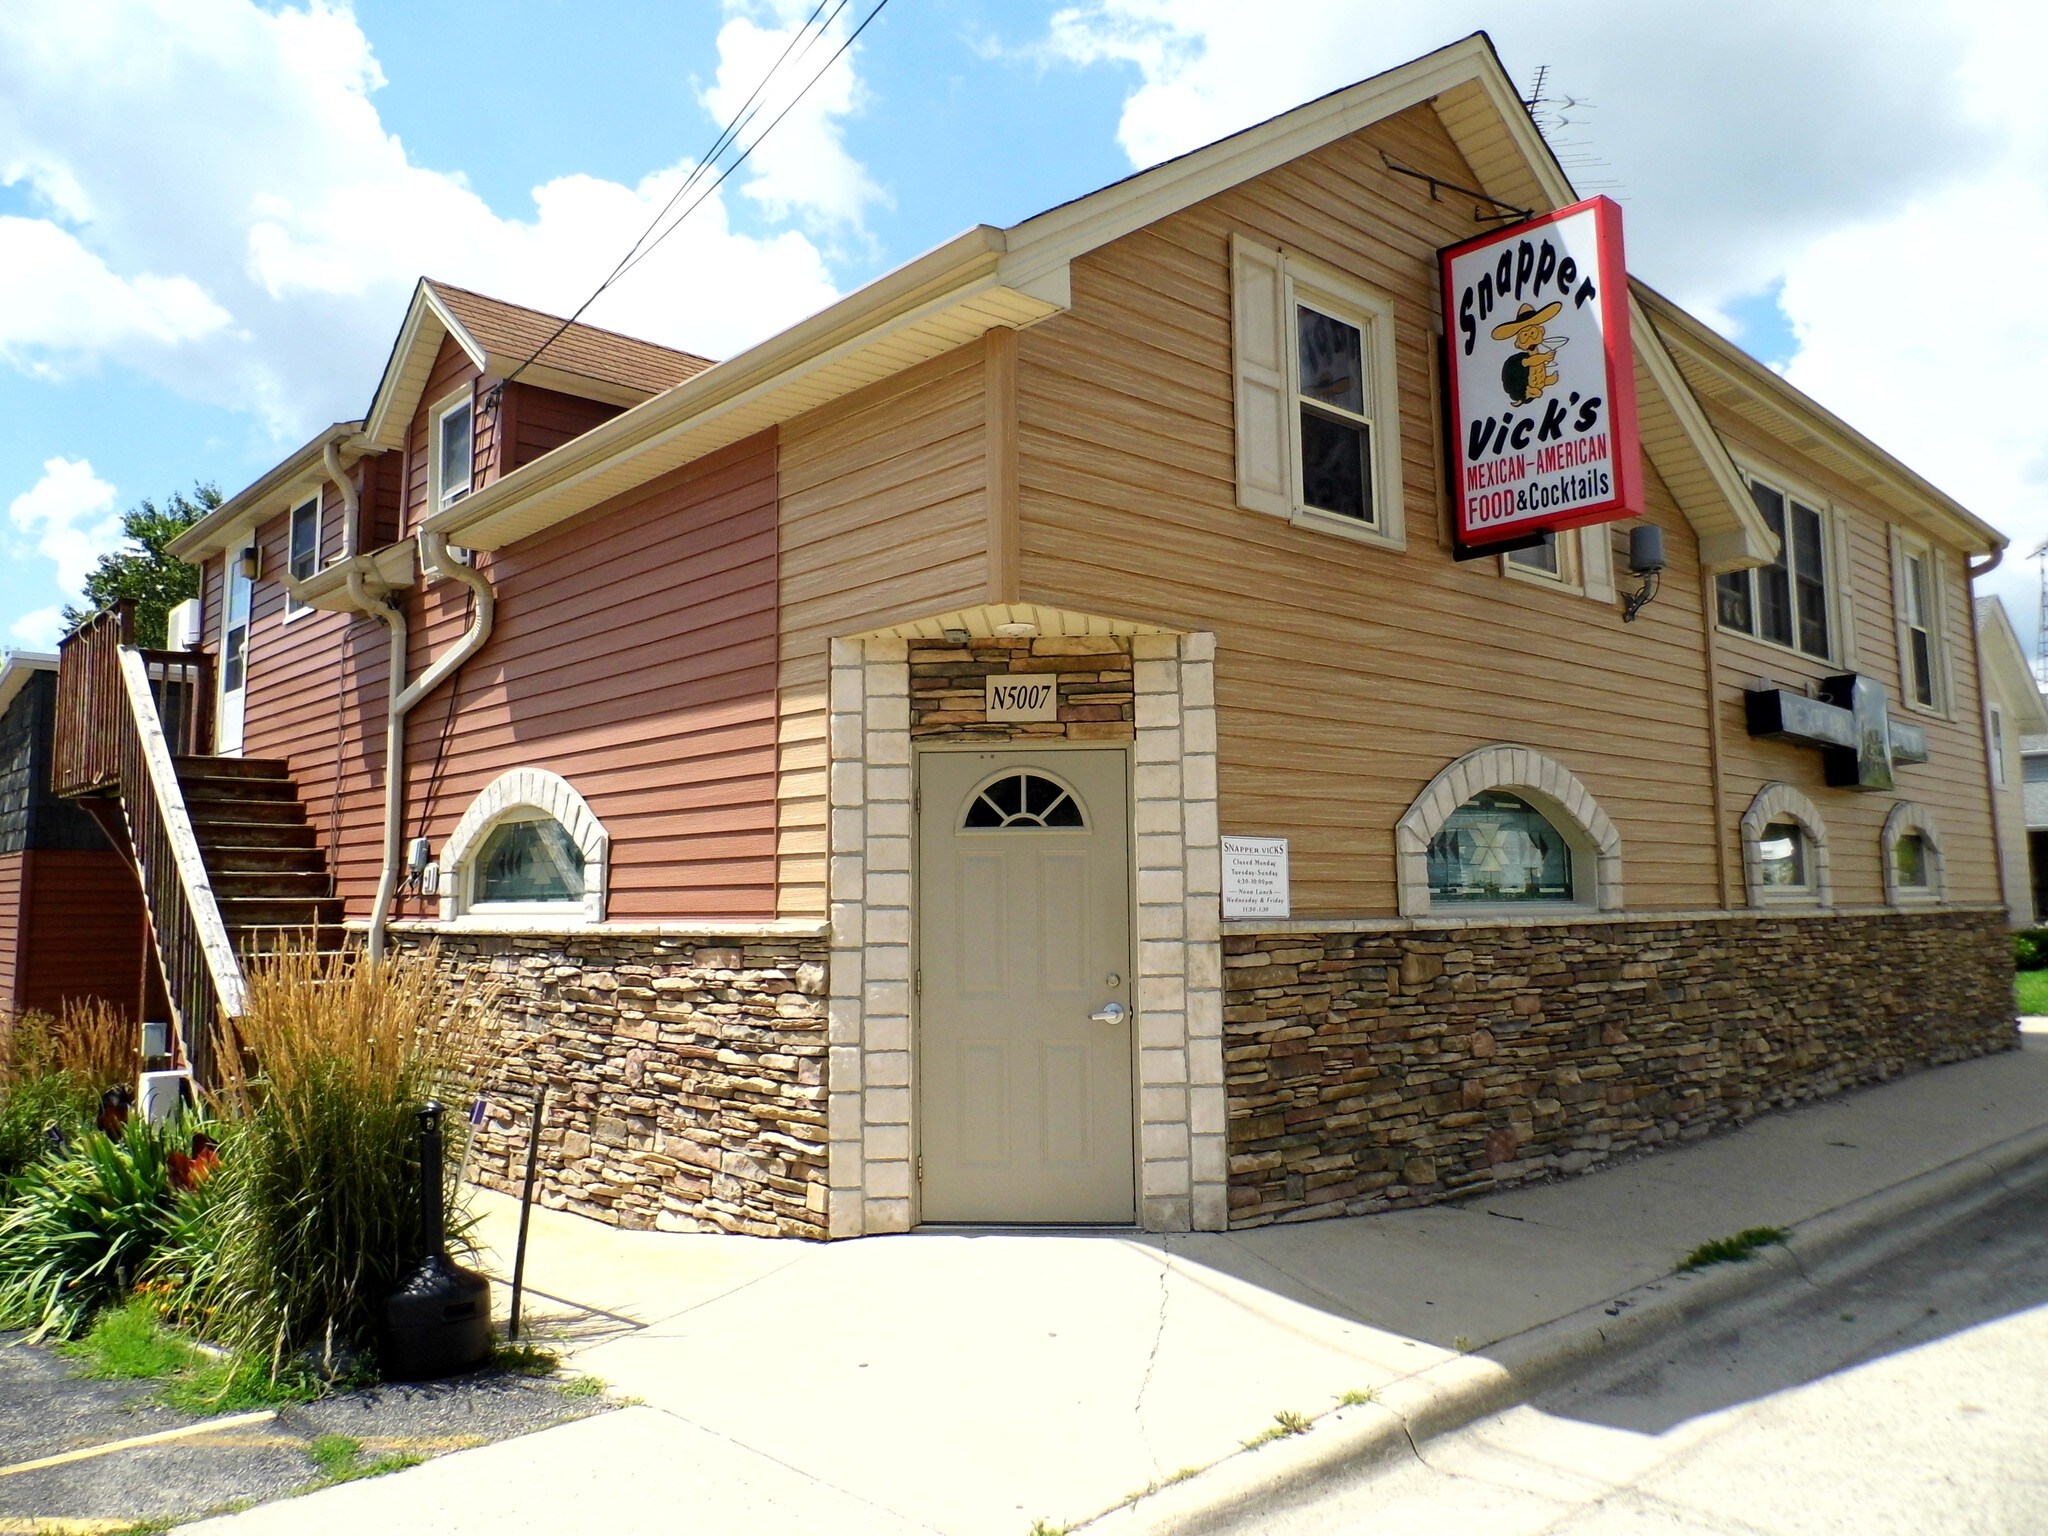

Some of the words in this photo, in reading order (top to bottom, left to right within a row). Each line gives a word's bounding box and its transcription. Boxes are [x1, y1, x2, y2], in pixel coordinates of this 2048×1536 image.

[1459, 238, 1597, 356] Snapper
[1467, 391, 1602, 462] Vick's
[1466, 433, 1607, 492] MEXICAN-AMERICAN
[991, 685, 1052, 710] N5007
[1224, 842, 1259, 854] SNAPPER
[1232, 858, 1253, 866] Closed
[1254, 859, 1276, 867] Monday
[1226, 896, 1258, 904] Wednesday
